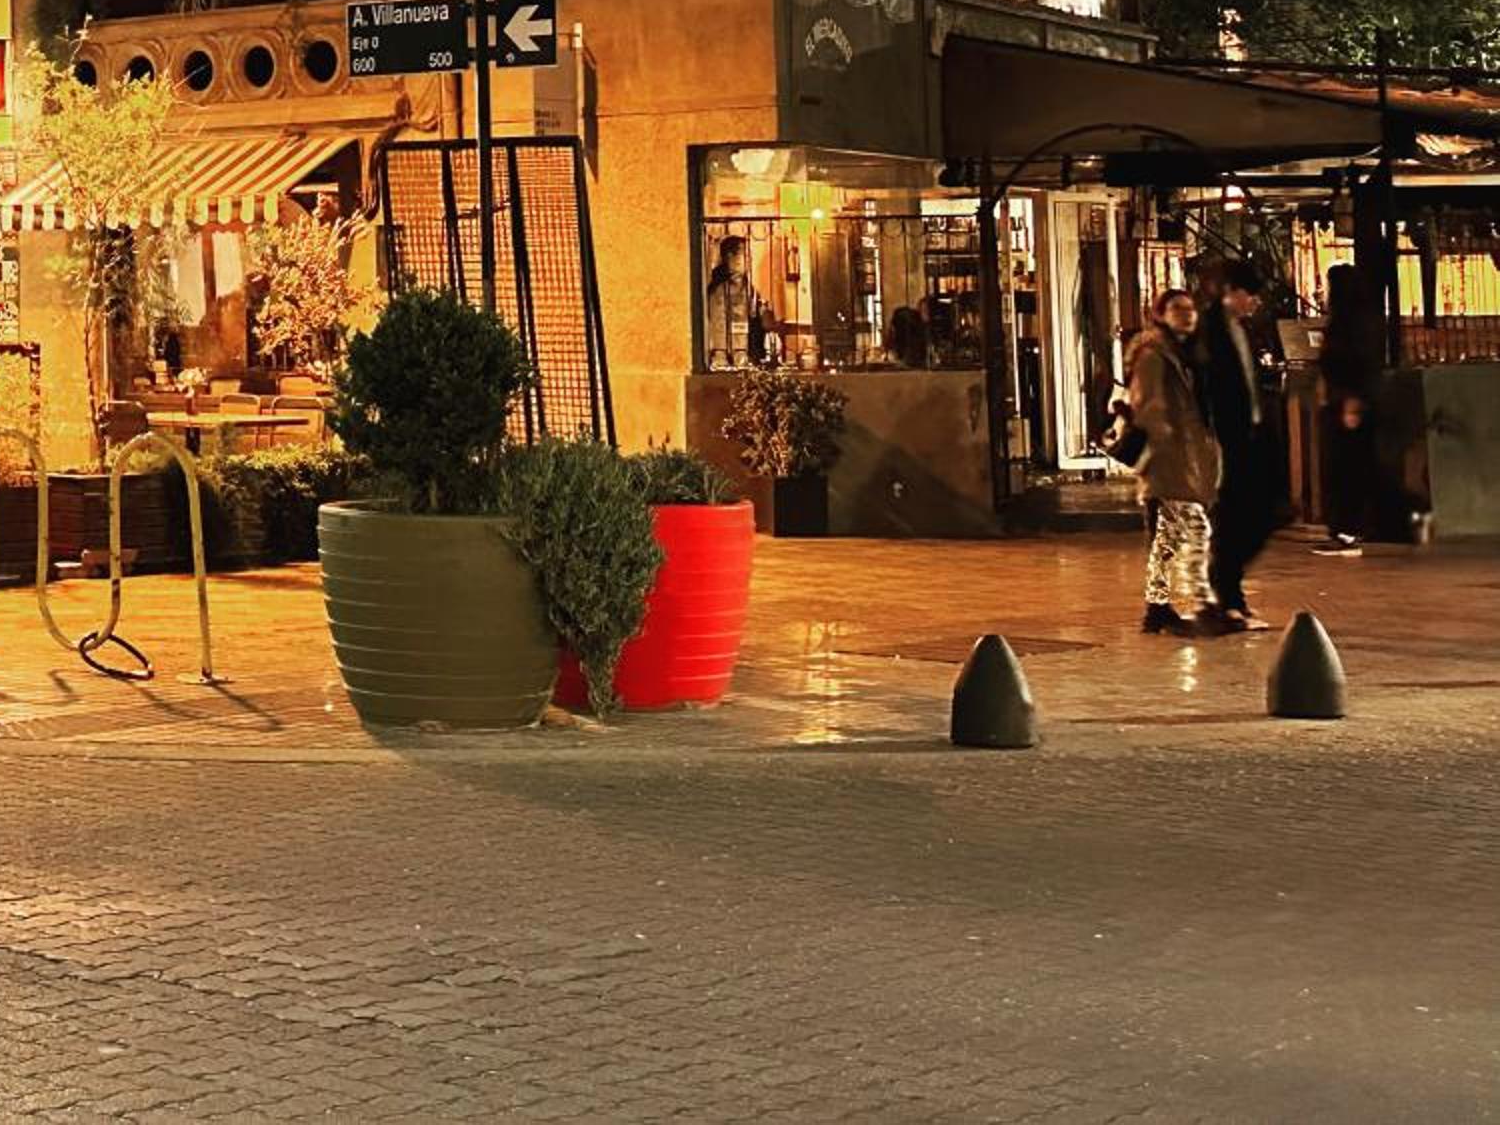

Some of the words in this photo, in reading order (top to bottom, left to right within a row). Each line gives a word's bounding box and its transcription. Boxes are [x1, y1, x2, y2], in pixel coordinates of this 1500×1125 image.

[352, 9, 368, 26] A.
[372, 4, 450, 26] Villanueva
[352, 57, 376, 73] 600
[429, 52, 453, 68] 500
